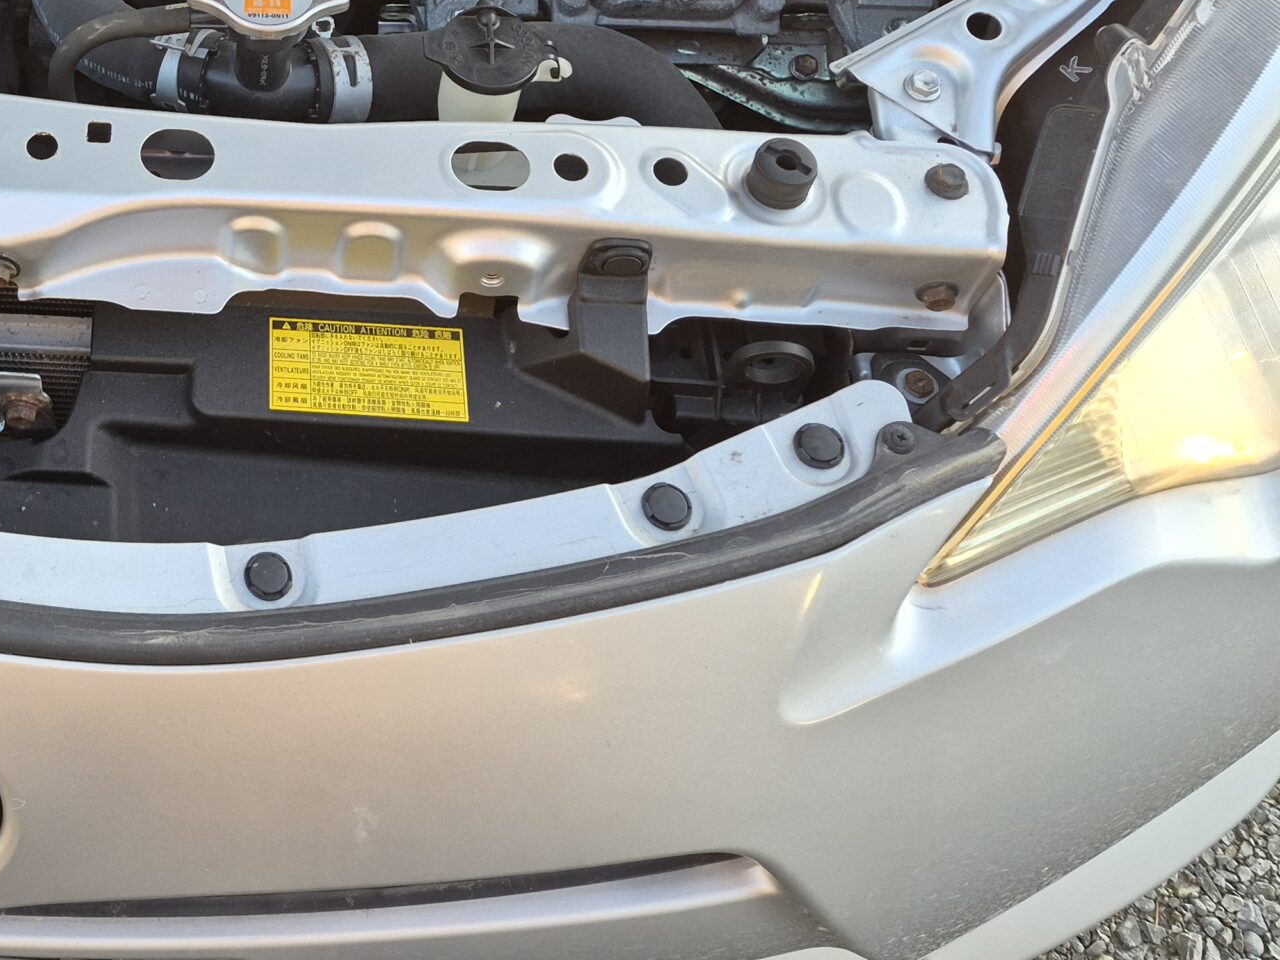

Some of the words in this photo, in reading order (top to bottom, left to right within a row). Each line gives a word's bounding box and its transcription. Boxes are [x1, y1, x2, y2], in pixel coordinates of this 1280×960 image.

[318, 323, 356, 334] CAUTION
[360, 325, 407, 337] ATTENTION
[273, 351, 295, 359] COOLING
[296, 352, 309, 360] FANS
[274, 366, 309, 375] VENTILATEURS
